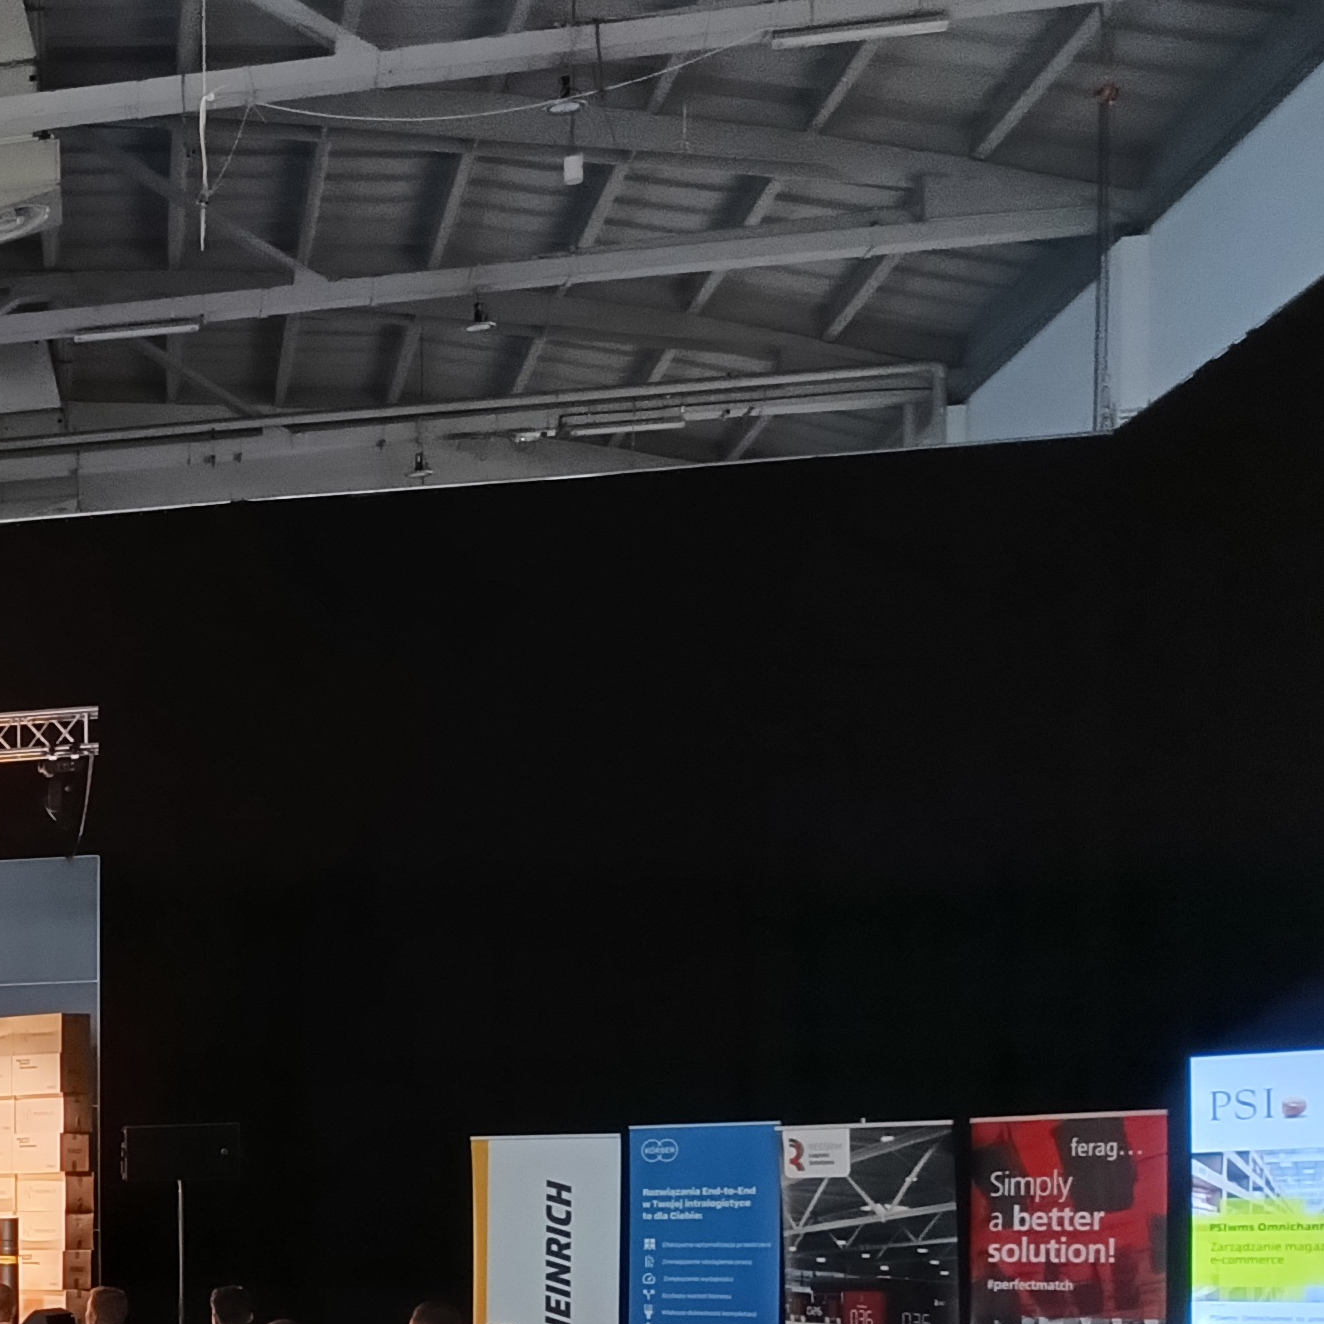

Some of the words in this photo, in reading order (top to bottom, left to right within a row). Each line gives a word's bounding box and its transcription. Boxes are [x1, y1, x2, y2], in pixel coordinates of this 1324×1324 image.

[1210, 1088, 1274, 1121] PSI
[702, 1186, 757, 1195] End-to-End
[990, 1168, 1073, 1203] Simply
[988, 1211, 1003, 1232] a
[1013, 1204, 1105, 1231] better
[987, 1236, 1116, 1263] solution!
[1210, 1256, 1285, 1265] e-commerce
[987, 1278, 1074, 1292] #perfectmatch
